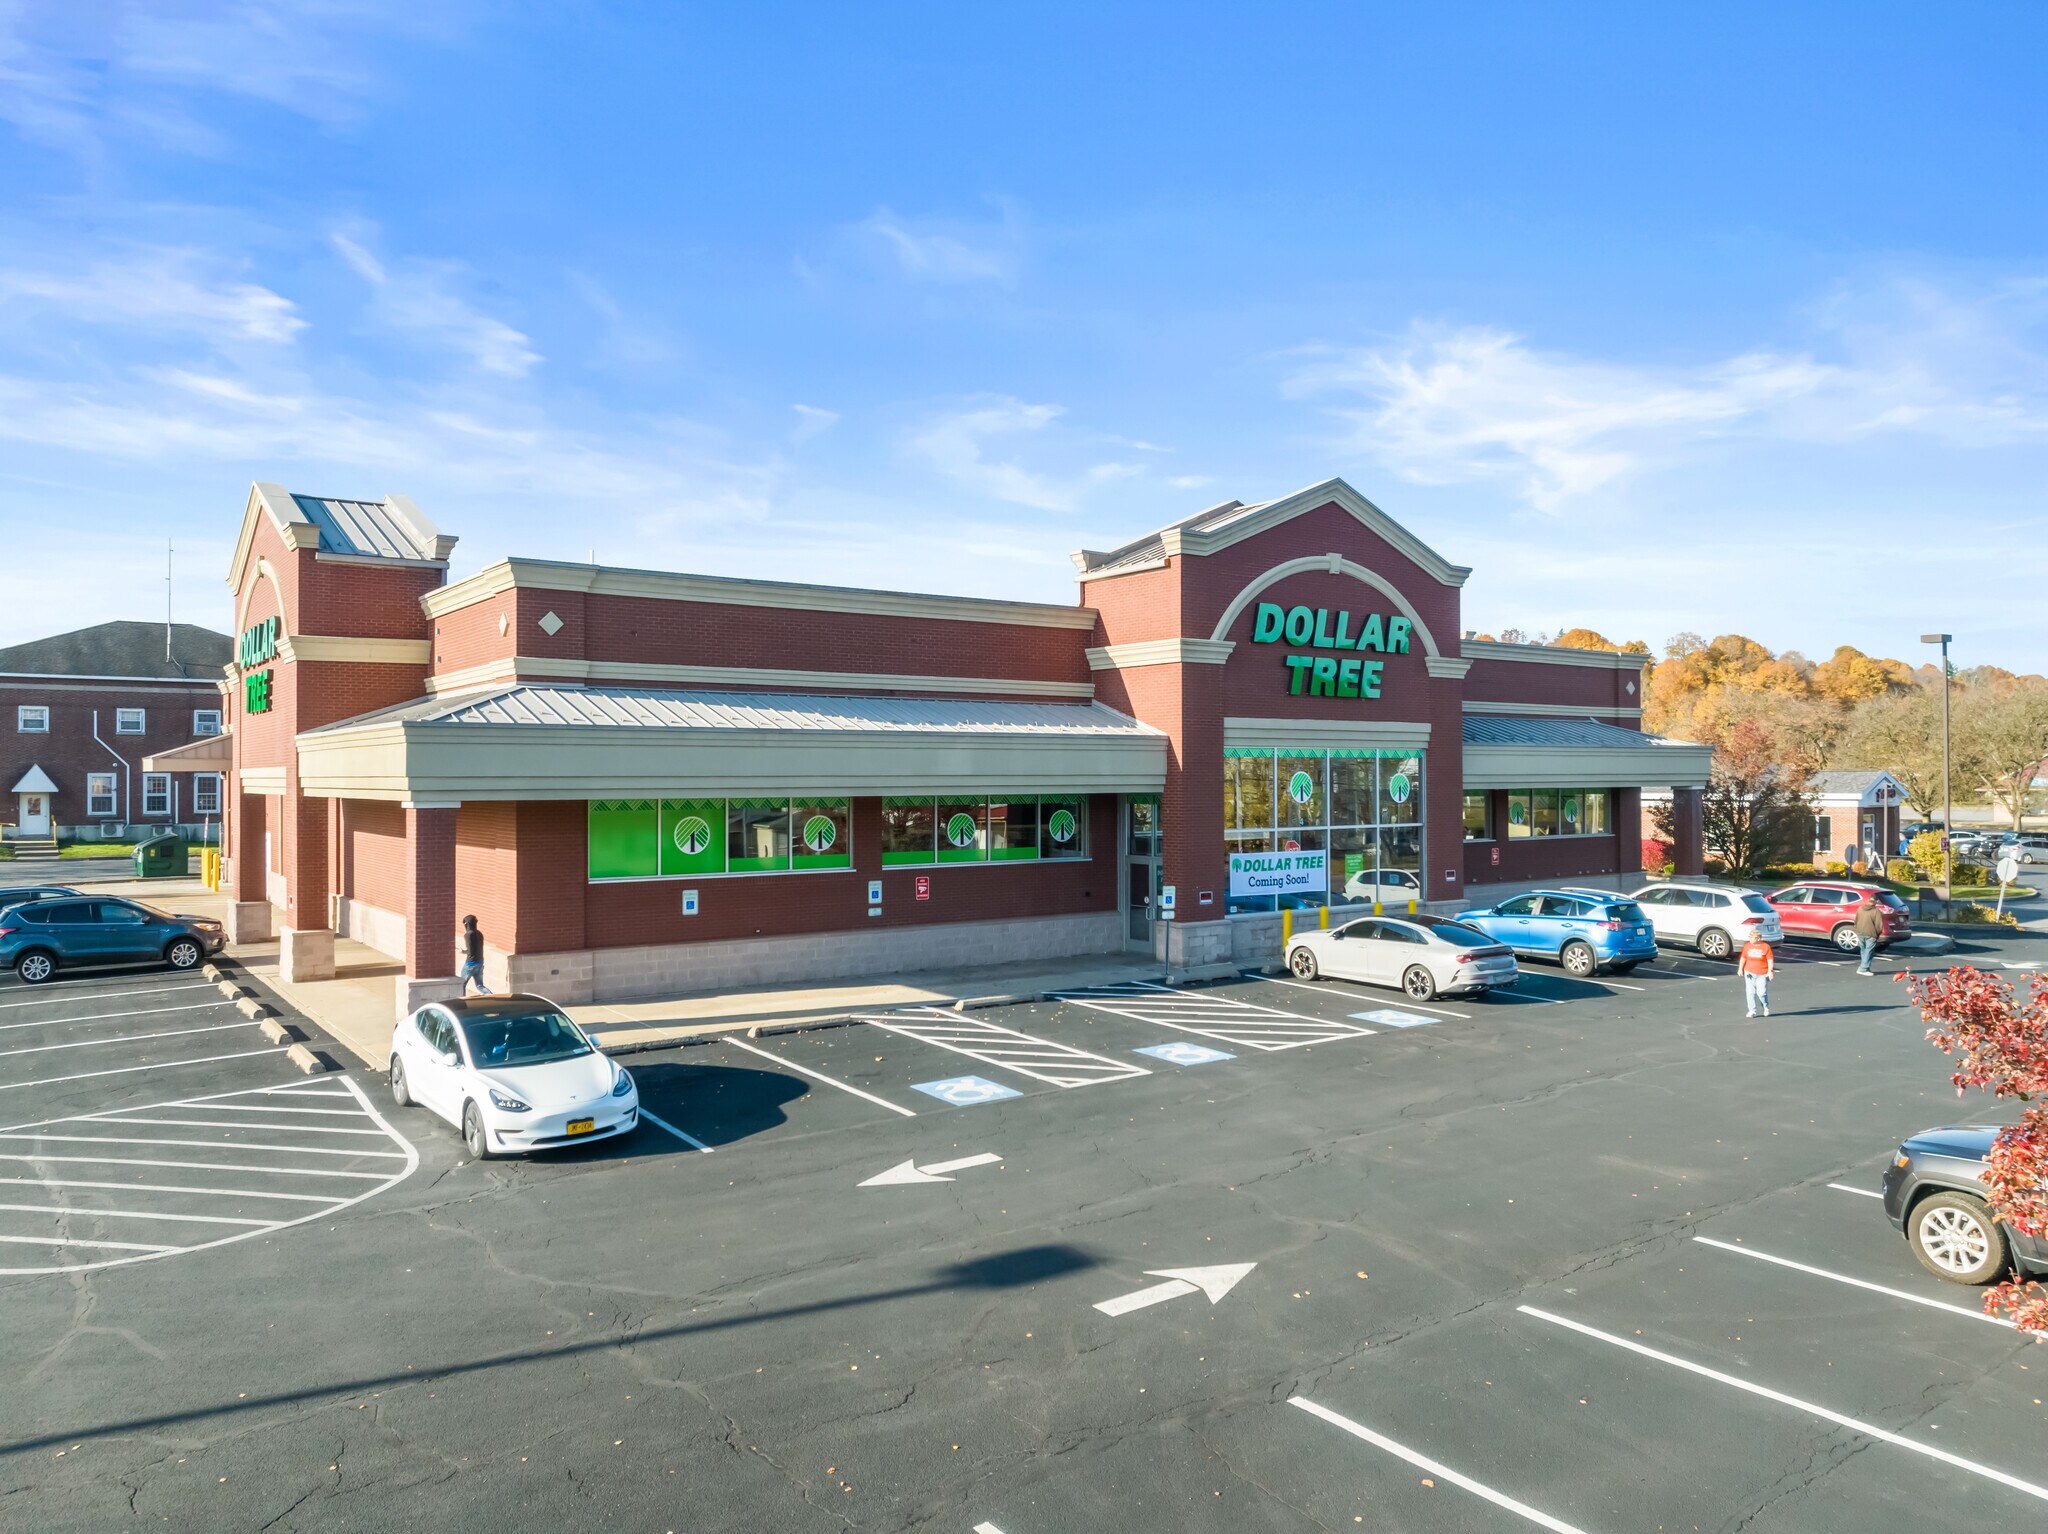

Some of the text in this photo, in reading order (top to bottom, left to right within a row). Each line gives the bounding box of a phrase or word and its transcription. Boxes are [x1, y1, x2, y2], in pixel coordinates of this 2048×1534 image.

[240, 615, 279, 670] DOLLAR
[1253, 602, 1412, 654] DOLLAR
[246, 669, 272, 714] TREE
[1285, 655, 1384, 699] TREE
[1243, 855, 1324, 873] DOLLAR TREE
[1248, 873, 1310, 889] Coming Soon!
